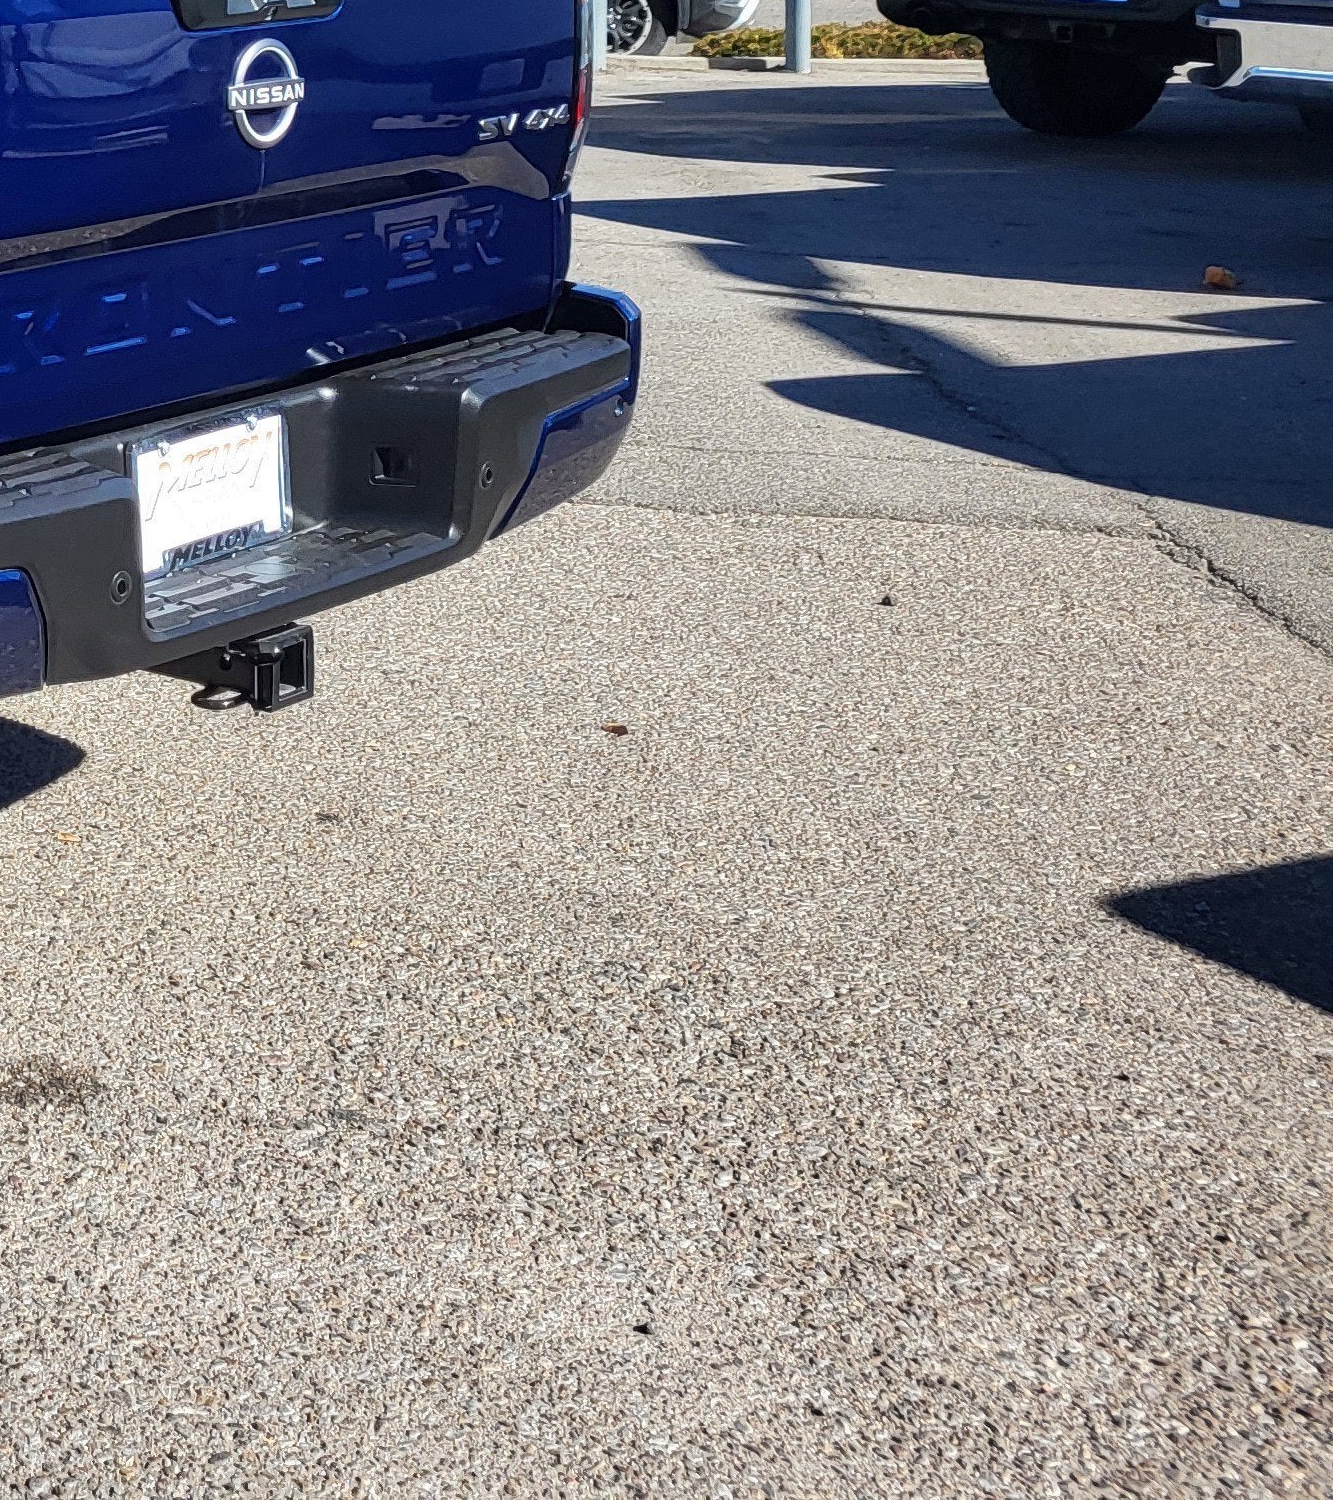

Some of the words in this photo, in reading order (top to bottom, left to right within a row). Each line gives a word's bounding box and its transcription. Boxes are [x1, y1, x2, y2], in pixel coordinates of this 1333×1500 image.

[230, 82, 305, 107] NISSAN
[477, 113, 520, 141] SV
[169, 526, 249, 571] MELLOY
